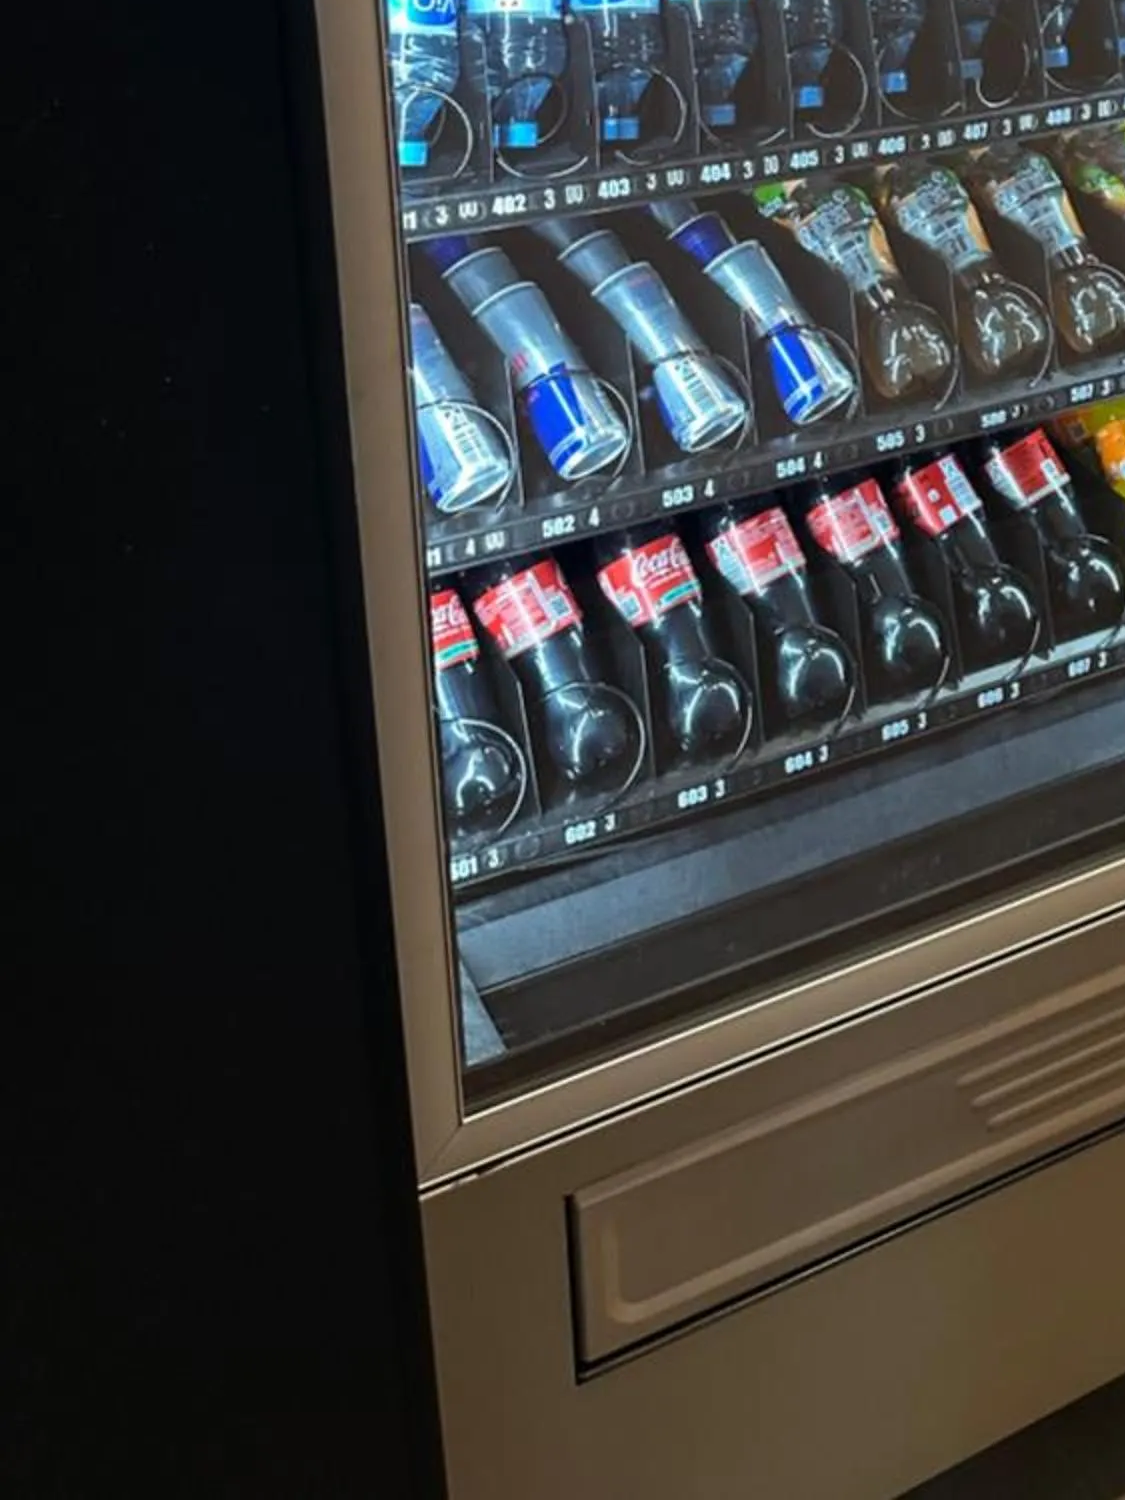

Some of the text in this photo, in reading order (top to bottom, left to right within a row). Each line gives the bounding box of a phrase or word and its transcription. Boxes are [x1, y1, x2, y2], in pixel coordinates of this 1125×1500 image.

[963, 121, 989, 141] 407
[1003, 118, 1013, 136] 3
[790, 149, 819, 170] 405
[834, 145, 845, 164] 3
[878, 135, 906, 155] 406
[700, 162, 732, 183] 404
[742, 160, 753, 180] 3
[598, 178, 631, 199] 403
[646, 172, 657, 191] 3
[435, 205, 449, 226] 3
[492, 194, 527, 216] 402
[544, 189, 556, 210] 3
[876, 424, 926, 452] 505 3
[775, 451, 823, 479] 504 4
[662, 478, 716, 508] 503 4
[542, 507, 600, 539] 502 4
[465, 537, 476, 557] 4
[784, 750, 813, 774] 604
[677, 779, 725, 809] 603 3
[565, 812, 617, 845] 602 3
[487, 848, 499, 869] 3
